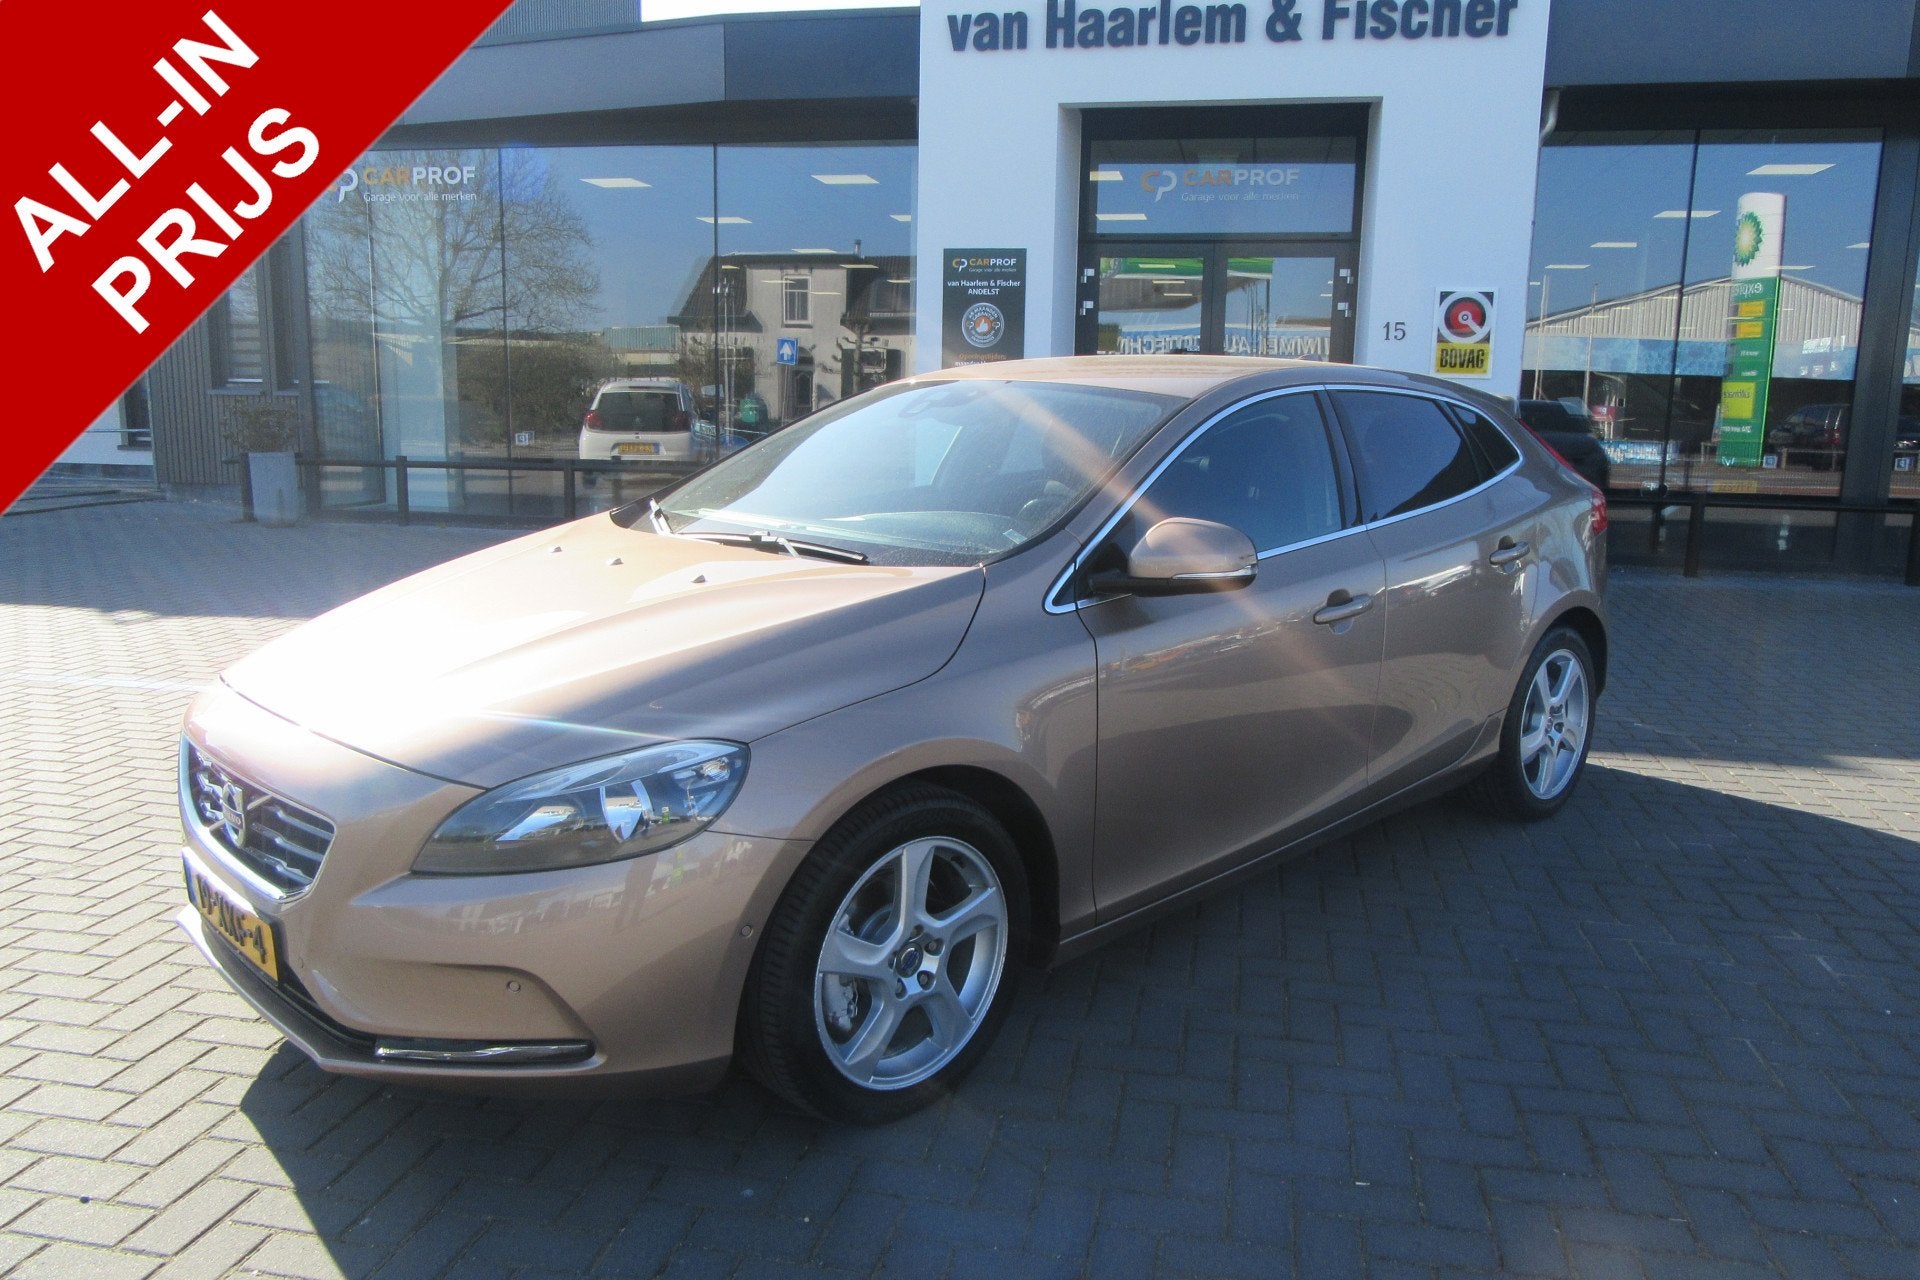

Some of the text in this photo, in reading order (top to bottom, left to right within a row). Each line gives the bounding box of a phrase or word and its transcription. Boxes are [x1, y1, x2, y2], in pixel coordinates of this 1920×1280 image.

[946, 0, 1519, 52] van Haarlem & Fischer
[363, 166, 476, 186] CARPROF
[1183, 168, 1299, 187] CARPROF
[363, 192, 397, 204] Garage
[423, 191, 438, 201] alle
[441, 191, 477, 201] merken
[1181, 192, 1215, 203] Garage
[1218, 192, 1240, 201] voor
[1243, 191, 1259, 201] alle
[969, 258, 1017, 266] CARPROF
[1382, 321, 1406, 341] 15
[1439, 348, 1485, 369] BOVAG
